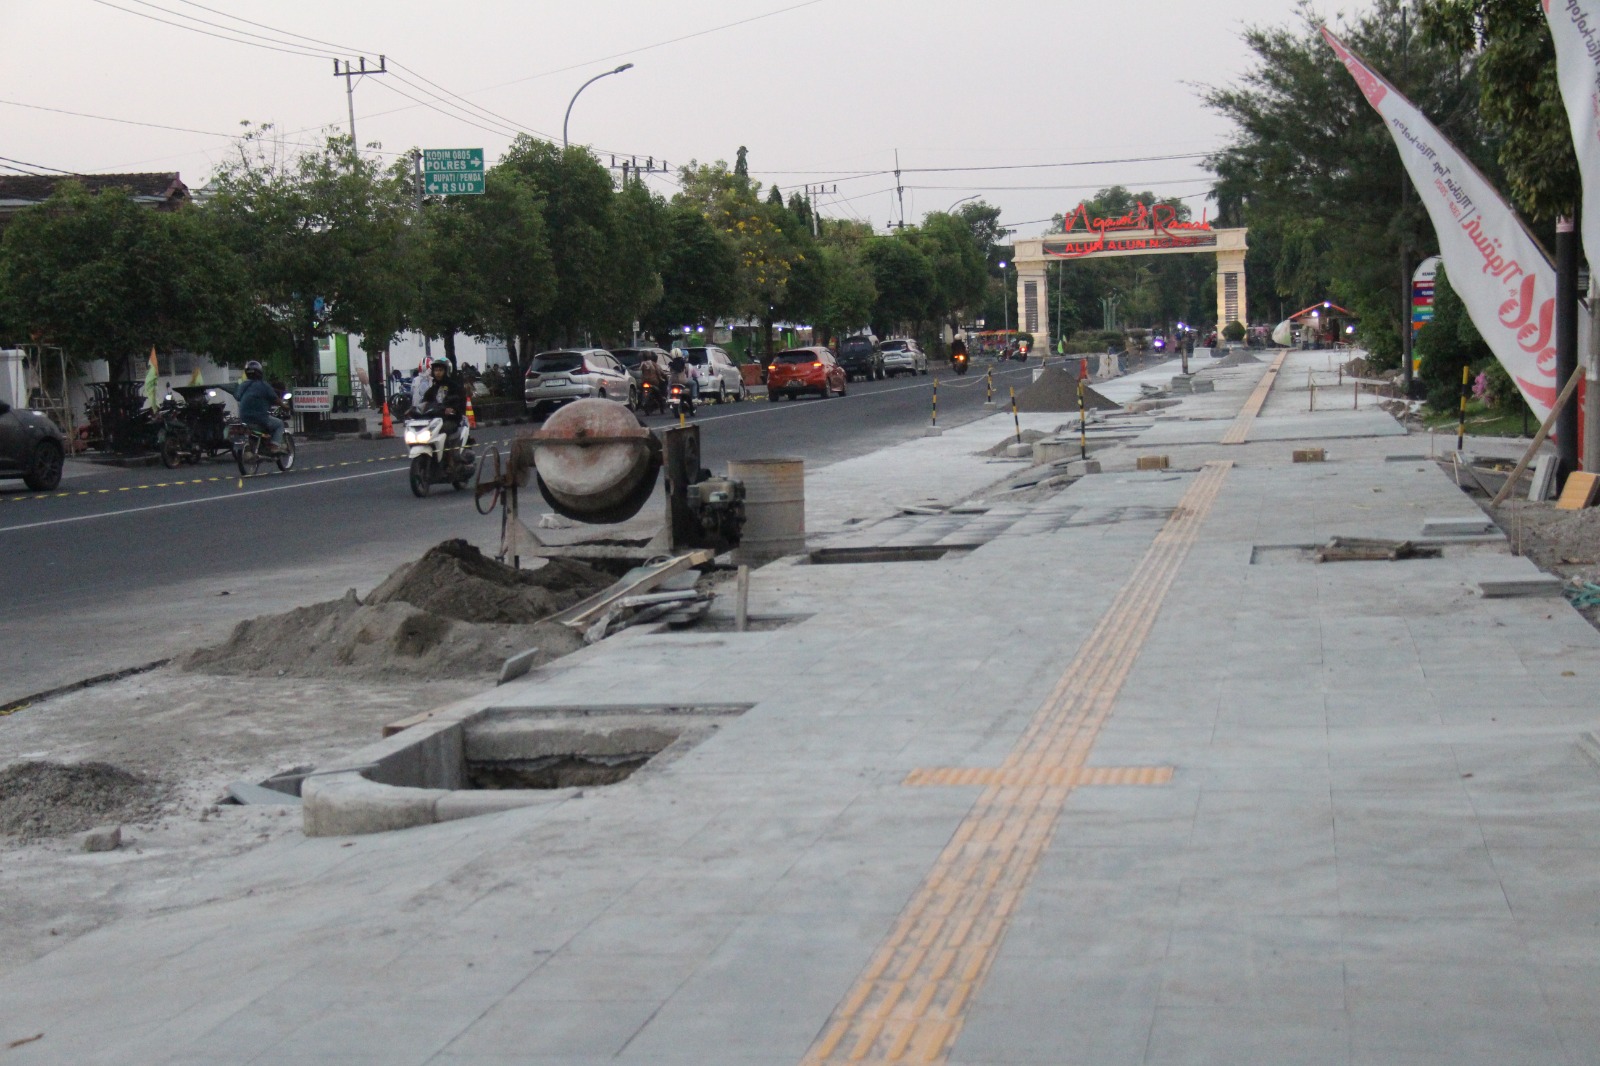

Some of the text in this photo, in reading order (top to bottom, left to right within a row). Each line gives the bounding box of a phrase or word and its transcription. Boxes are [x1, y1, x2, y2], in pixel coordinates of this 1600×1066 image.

[426, 151, 450, 160] KODIM
[426, 161, 467, 170] POLRES
[433, 174, 456, 182] BUPATI
[460, 173, 481, 181] PEMDA
[442, 183, 474, 192] RSUD
[1065, 240, 1104, 253] ALUN
[1107, 240, 1146, 251] ALUN
